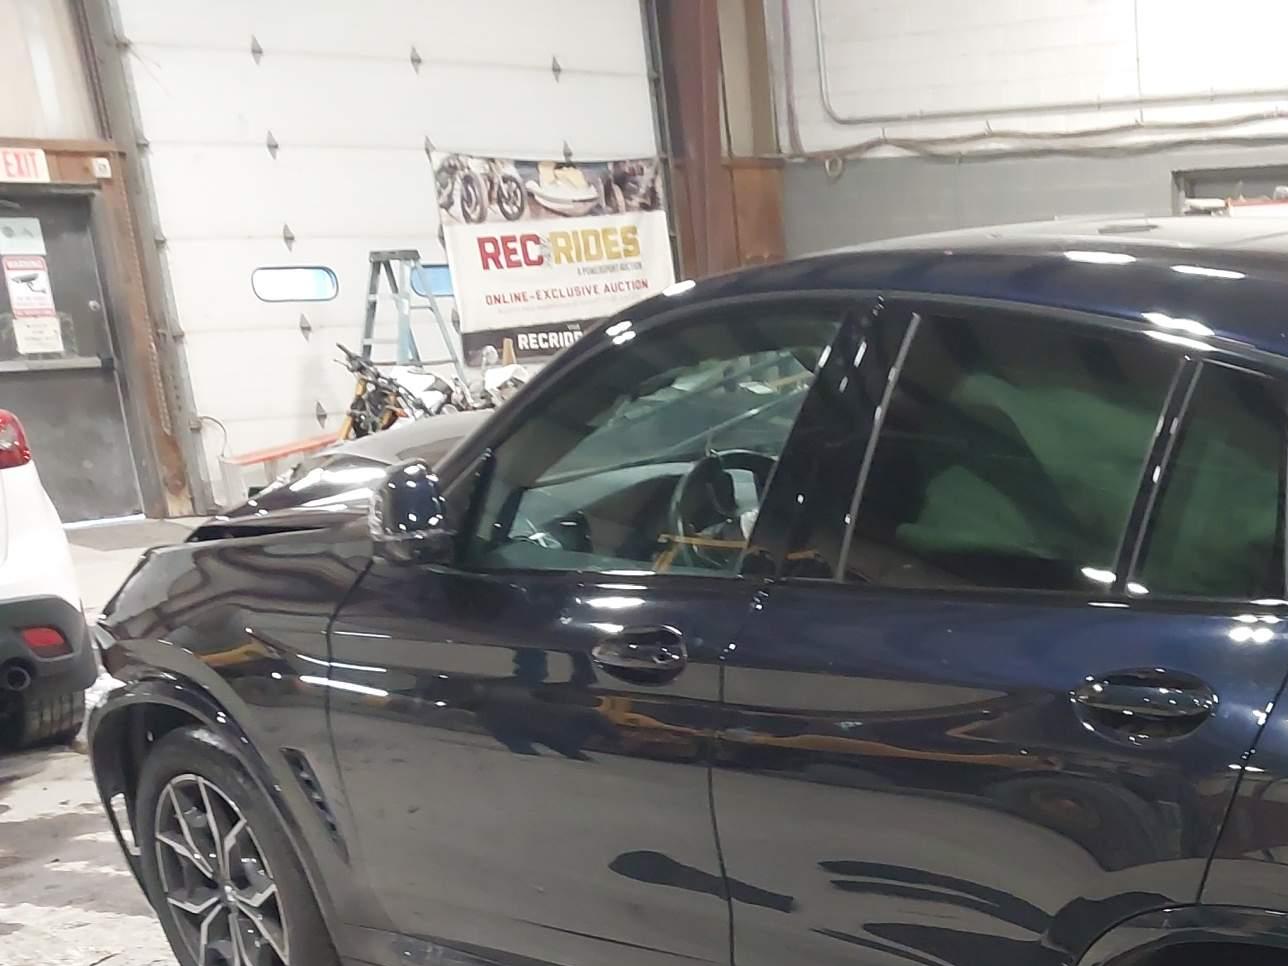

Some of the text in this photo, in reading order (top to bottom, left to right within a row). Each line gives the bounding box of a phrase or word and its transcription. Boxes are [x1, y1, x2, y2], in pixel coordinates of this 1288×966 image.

[1, 150, 39, 178] EXIT
[477, 224, 641, 270] REC RIDES
[485, 284, 600, 306] ONLINE-EXCLUSIVE
[603, 279, 649, 294] AUCTION
